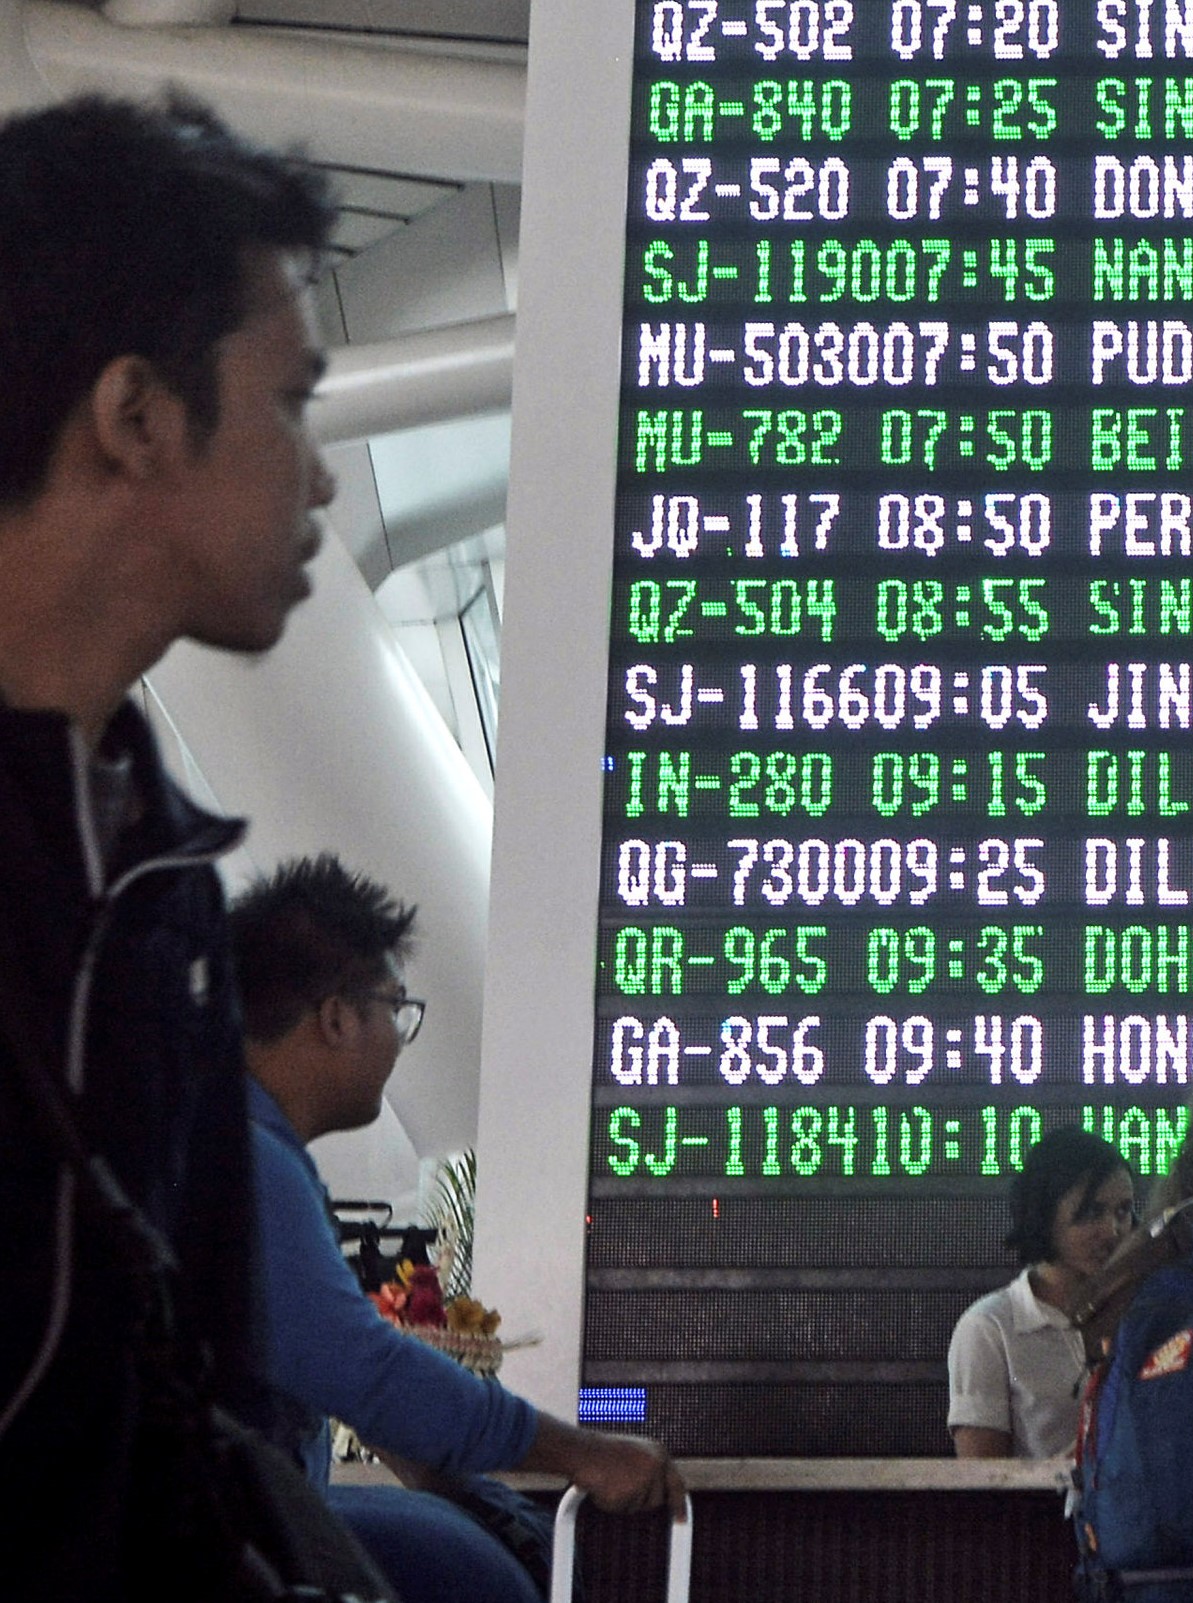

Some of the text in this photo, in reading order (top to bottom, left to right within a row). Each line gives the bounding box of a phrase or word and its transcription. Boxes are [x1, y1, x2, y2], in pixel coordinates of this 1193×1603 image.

[651, 0, 854, 62] QZ-502
[889, 0, 1059, 61] 07:20
[649, 79, 852, 143] GA-840
[889, 78, 1058, 141] 07:25
[643, 156, 850, 223] QZ-520
[885, 155, 1057, 221] 07:40
[635, 409, 842, 473] MU-782
[880, 409, 1052, 472] 07:50
[631, 493, 840, 559] JQ-117
[877, 493, 1051, 558] 08:50
[628, 579, 837, 643] QZ-504
[876, 578, 1049, 642] 08:55
[625, 751, 833, 818] IN-280
[871, 751, 1046, 817] 09:15
[614, 925, 827, 995] QR-965
[867, 925, 1044, 994] 09:35
[610, 1015, 825, 1086] GA-856
[867, 1014, 1043, 1087] 09:40
